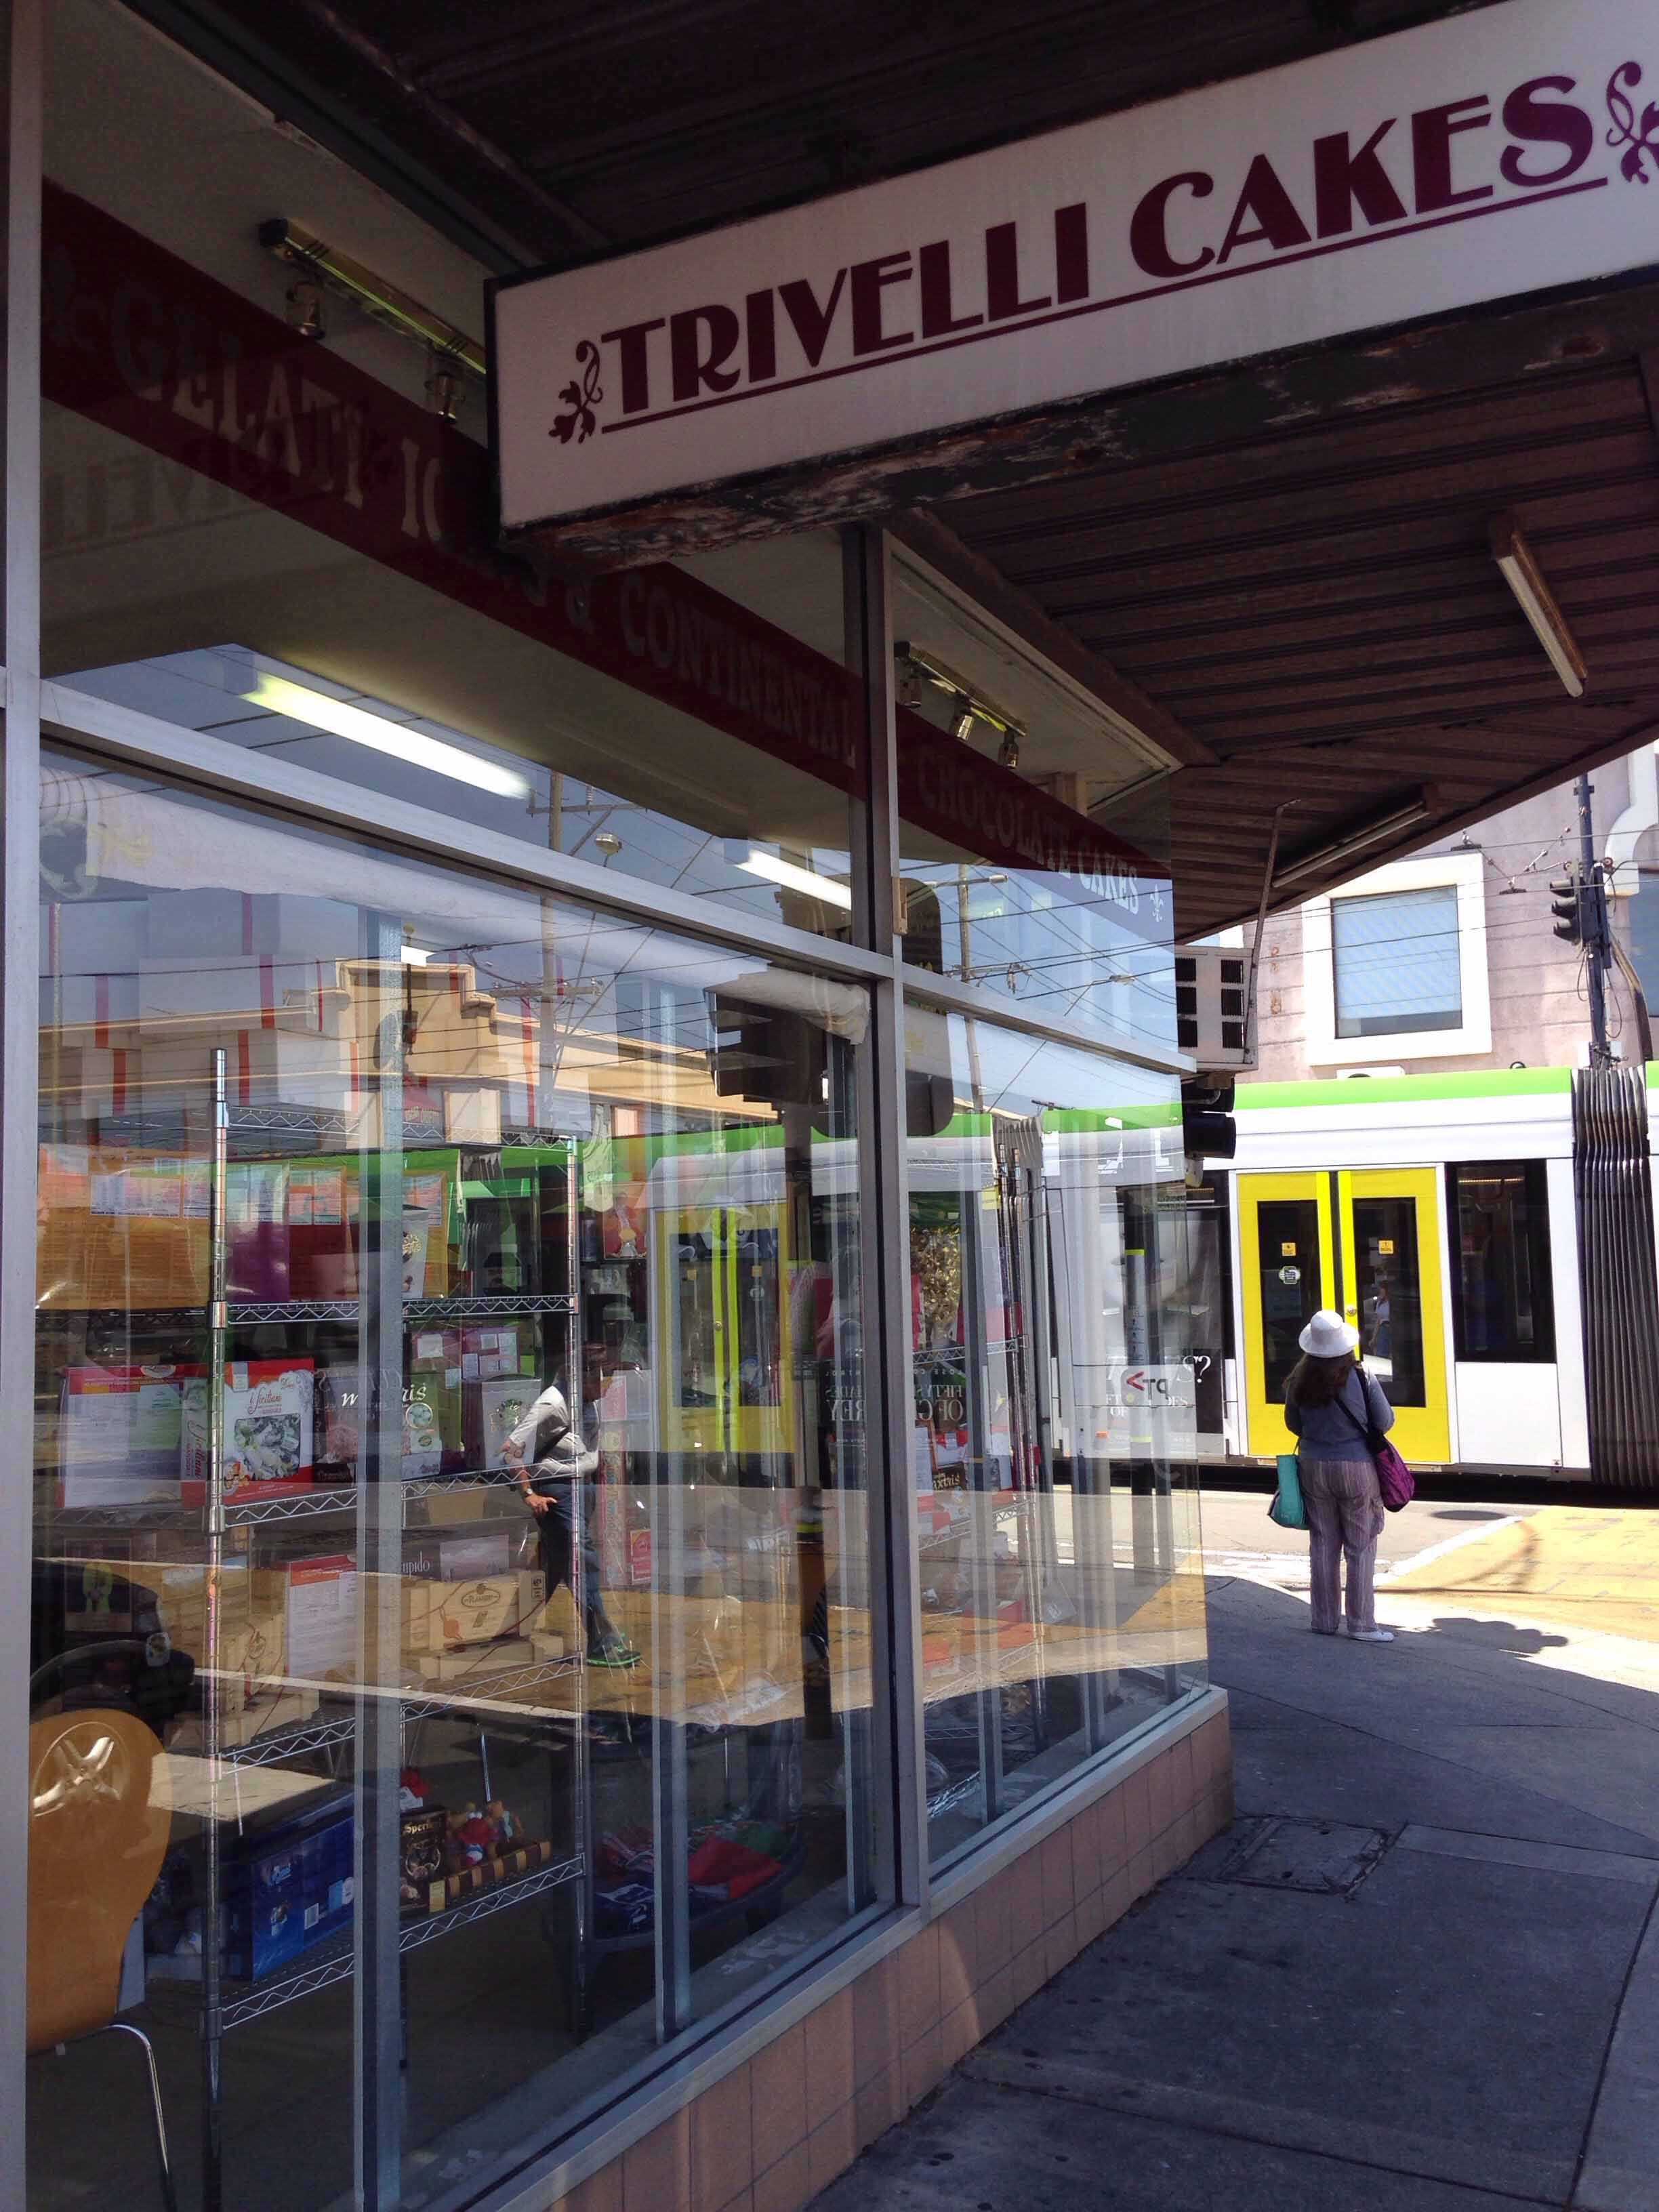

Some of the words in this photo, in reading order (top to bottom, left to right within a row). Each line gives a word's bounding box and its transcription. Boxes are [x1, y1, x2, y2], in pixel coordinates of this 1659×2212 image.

[600, 202, 1090, 415] TRIVELLI
[1131, 75, 1593, 278] CAKES
[1078, 836, 1140, 916] CAKES
[402, 1551, 430, 1578] upido
